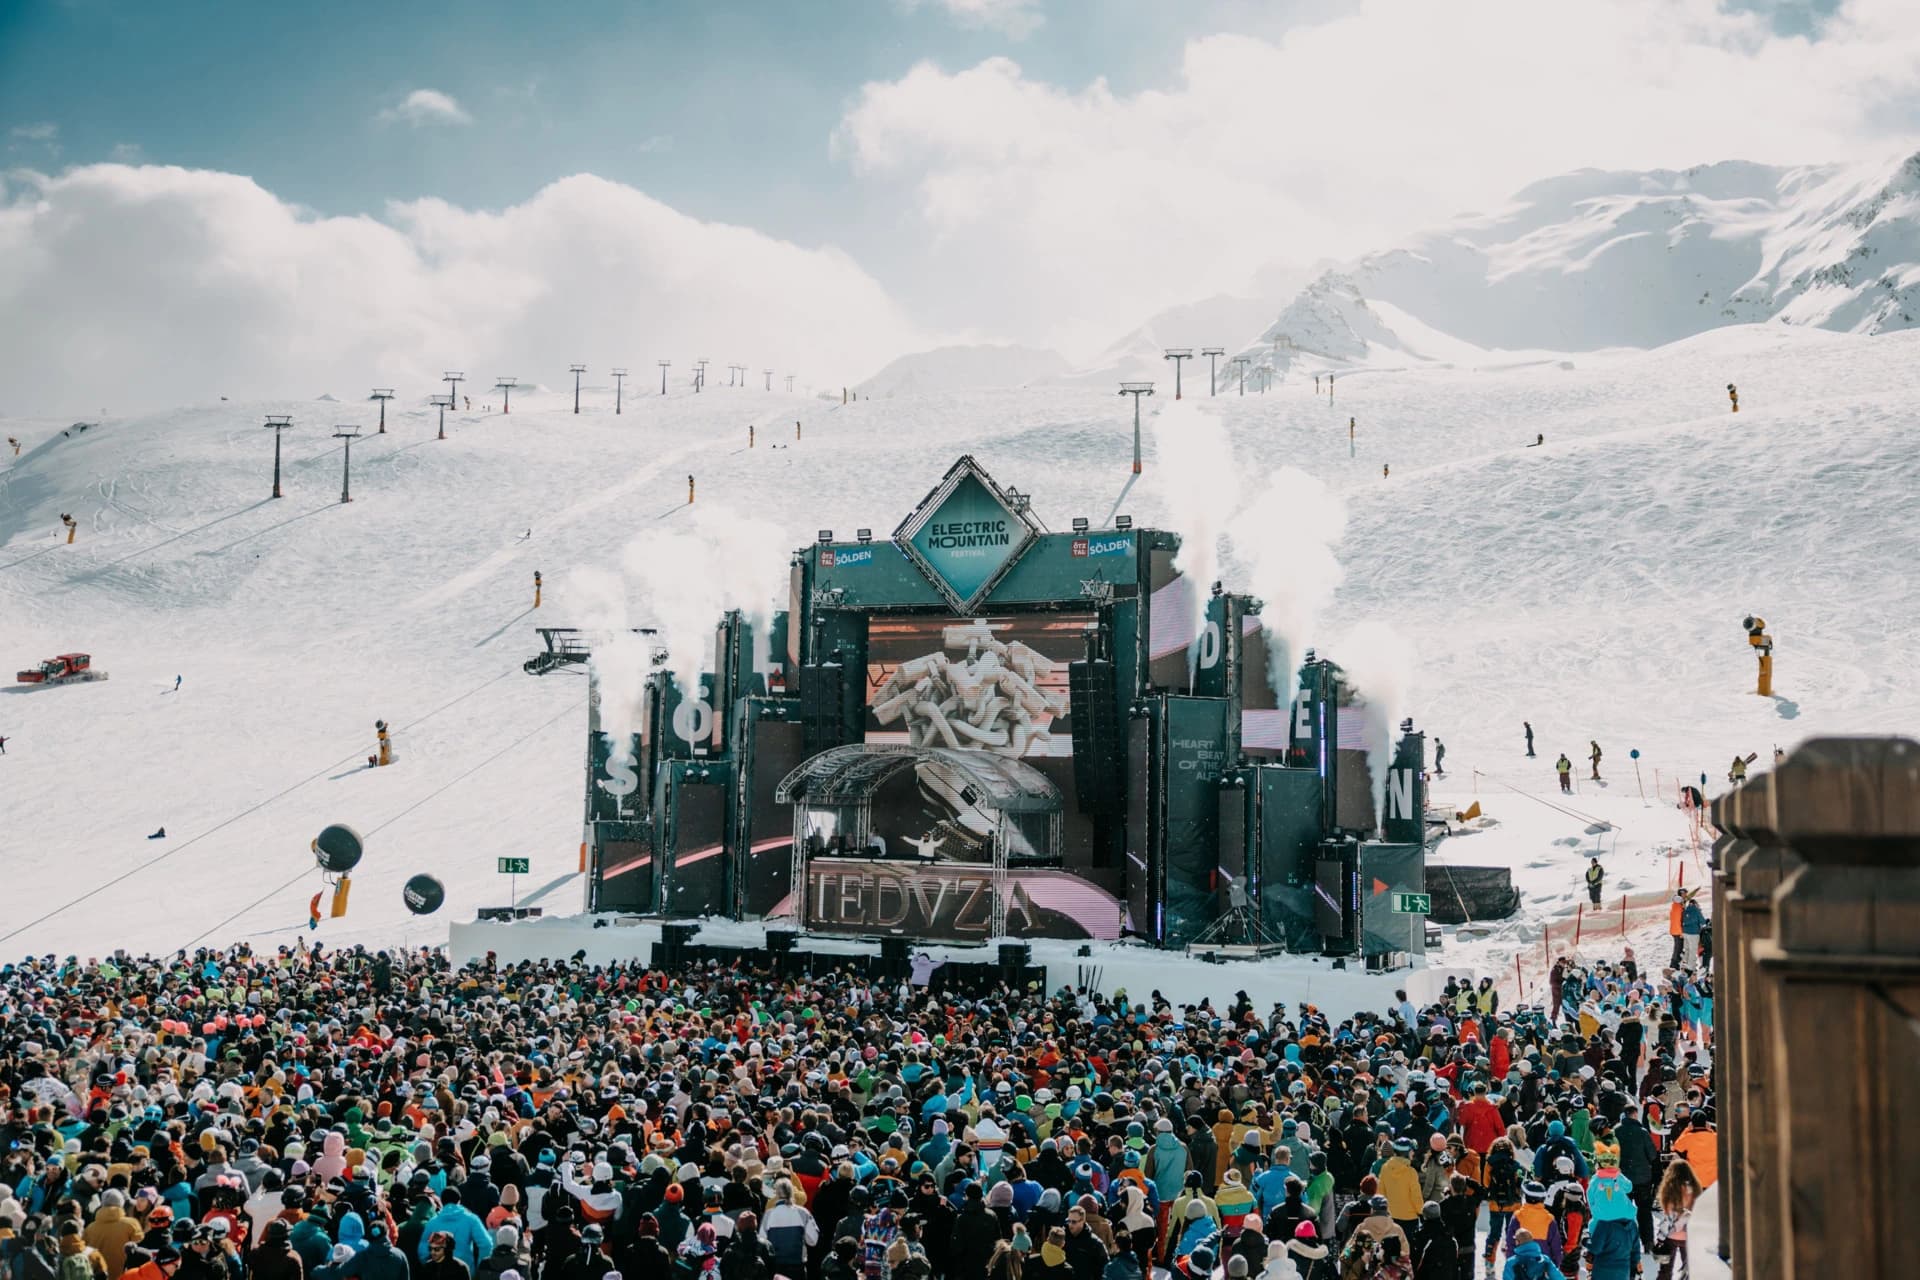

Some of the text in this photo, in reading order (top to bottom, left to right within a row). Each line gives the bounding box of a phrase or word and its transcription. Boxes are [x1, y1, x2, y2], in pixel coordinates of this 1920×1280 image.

[932, 520, 1006, 536] ELECTRIC
[928, 533, 1009, 549] MOUNTAIN
[1089, 538, 1131, 555] SÖLDEN
[836, 551, 872, 565] SÖLDEN
[1296, 688, 1312, 739] E
[1172, 740, 1215, 749] HEART
[1198, 751, 1224, 760] BEAT
[1178, 761, 1219, 770] OF THE
[1196, 771, 1219, 781] ALP
[1389, 768, 1413, 820] N
